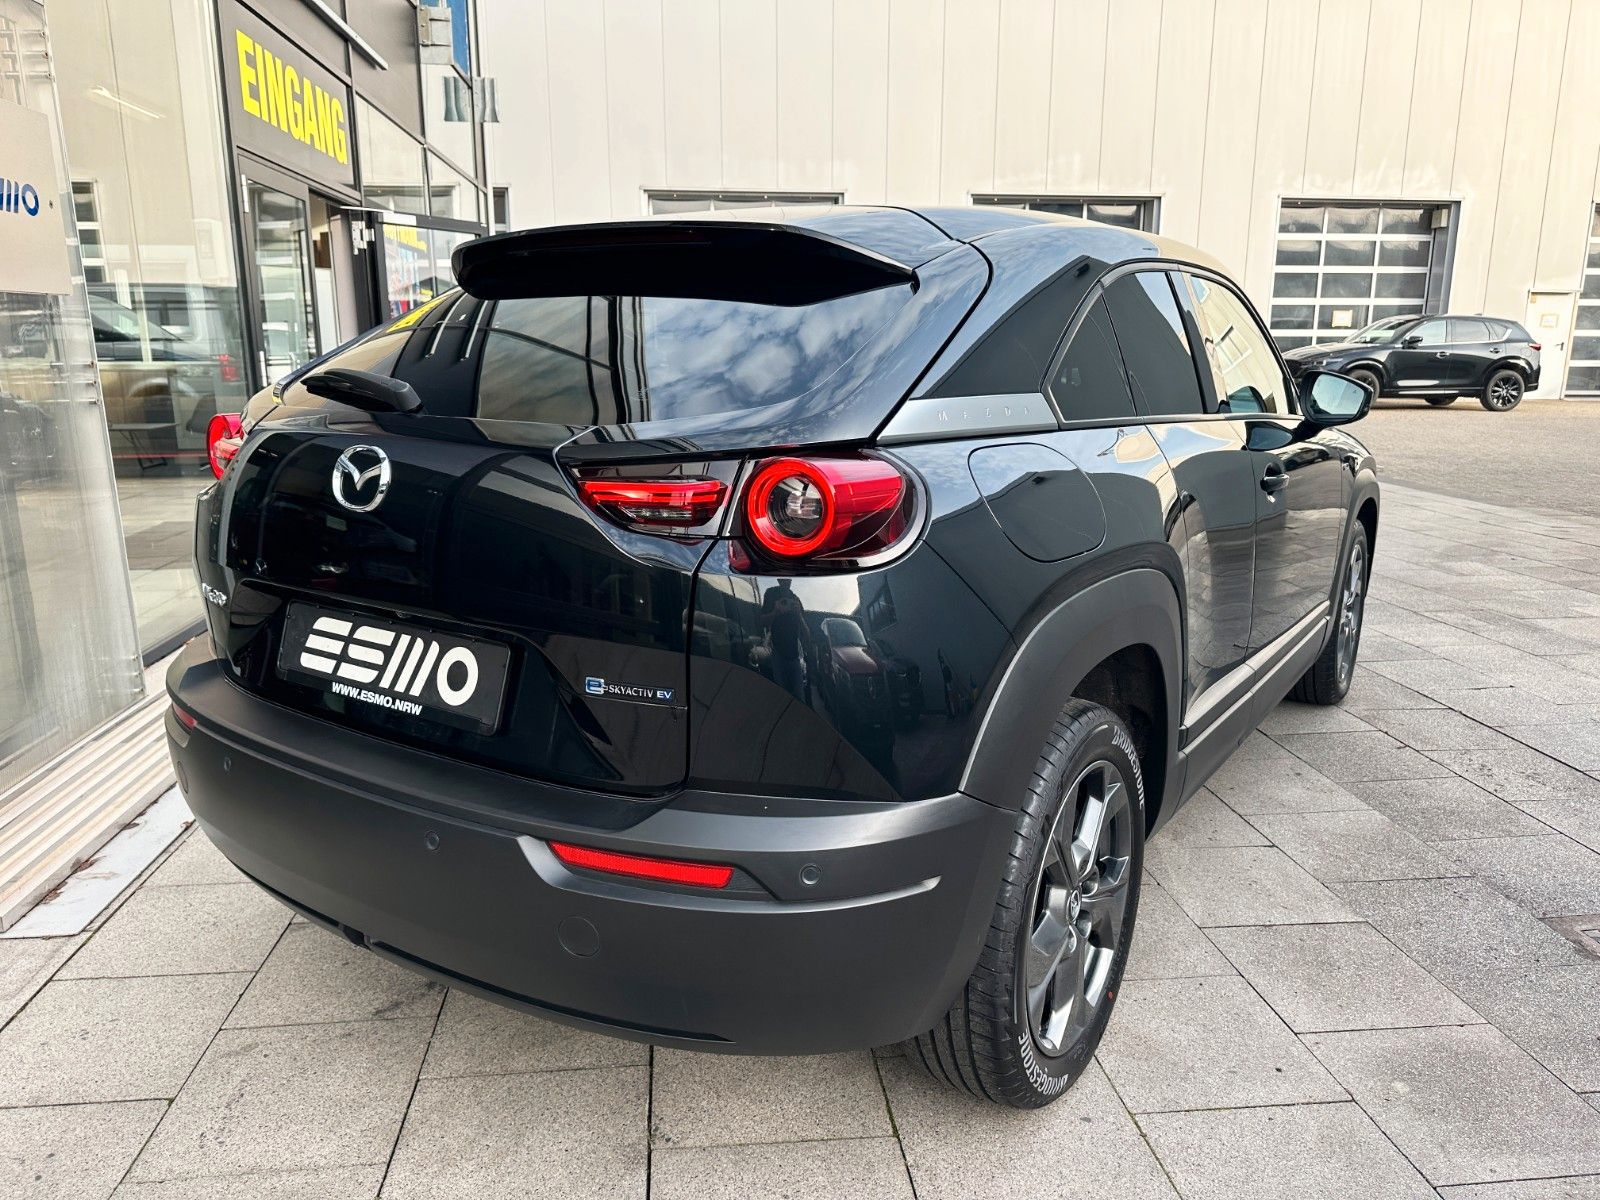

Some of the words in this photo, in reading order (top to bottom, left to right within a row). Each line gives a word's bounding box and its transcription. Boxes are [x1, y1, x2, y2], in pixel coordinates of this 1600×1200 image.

[236, 29, 348, 165] EINGANG
[300, 616, 479, 707] ESMO
[331, 681, 422, 716] WWW.ESMO.NRW
[656, 690, 672, 699] EV
[1112, 725, 1145, 810] BRIDGESTONE
